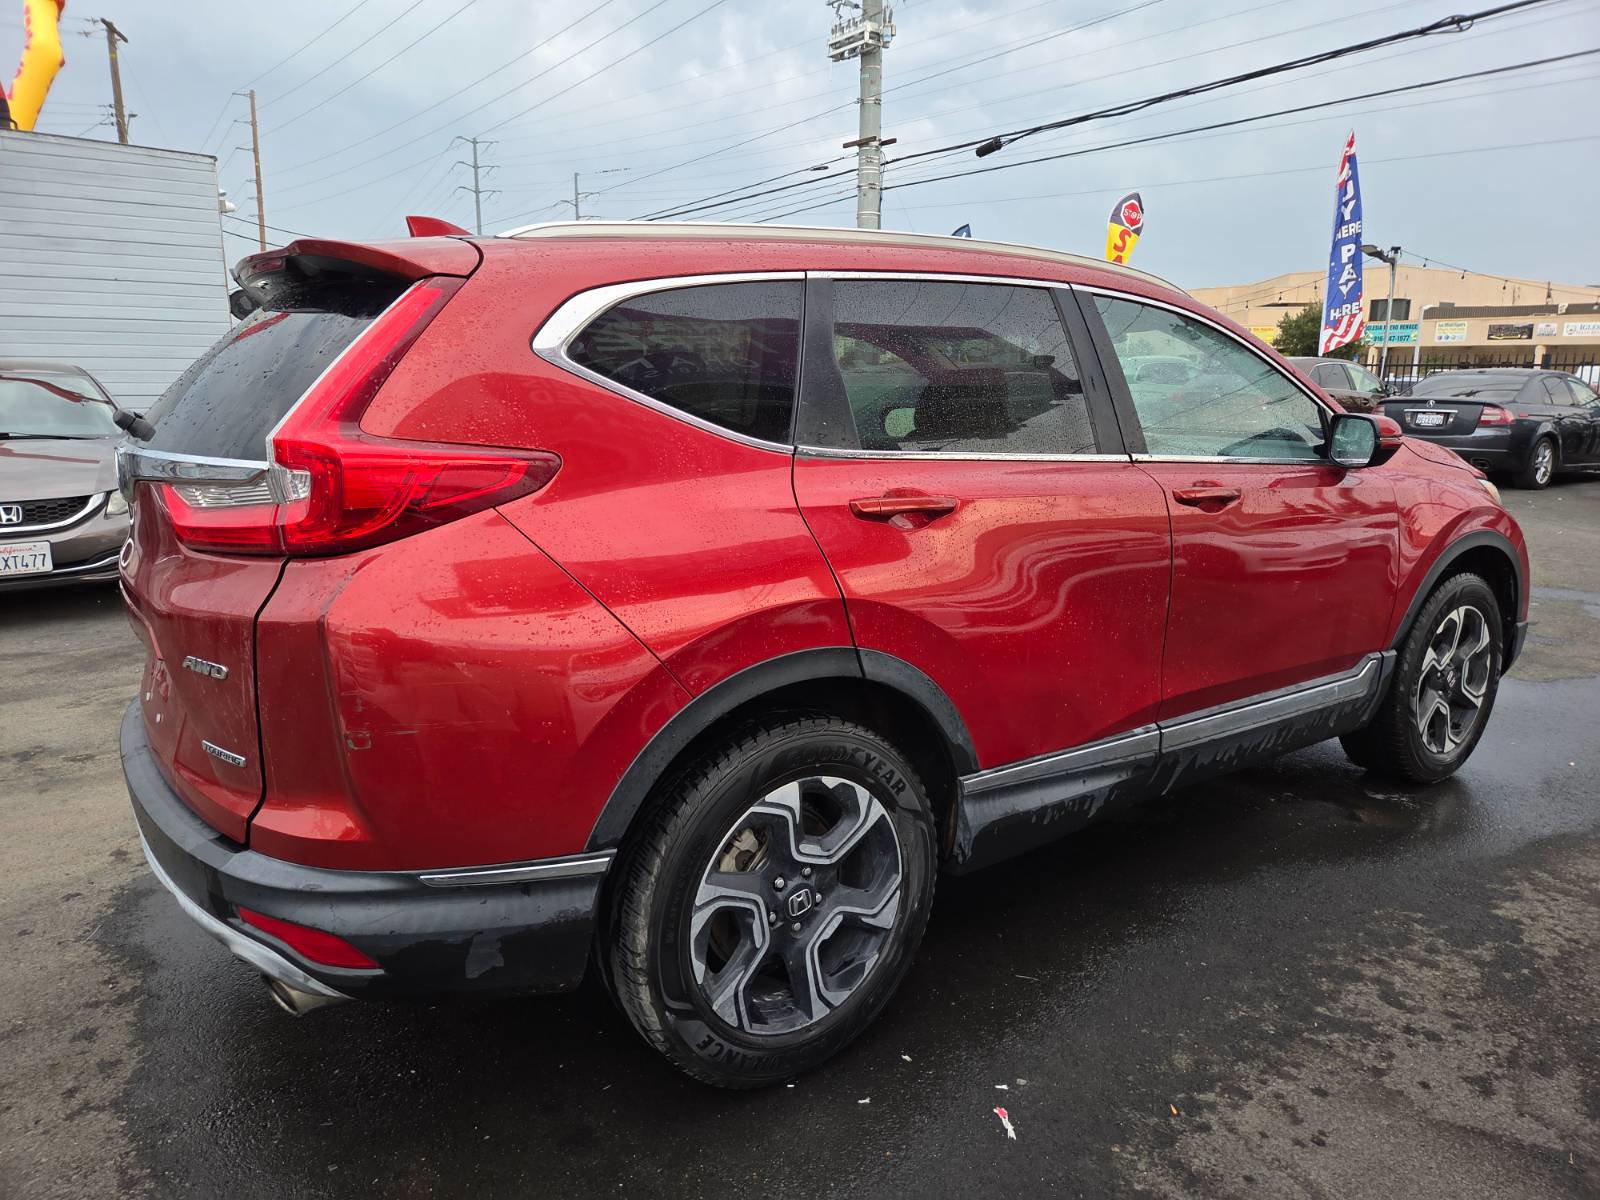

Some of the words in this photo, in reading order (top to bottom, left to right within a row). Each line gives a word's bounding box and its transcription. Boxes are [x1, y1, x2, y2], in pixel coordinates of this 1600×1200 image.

[1329, 301, 1361, 321] HRE
[0, 553, 46, 571] XT477
[182, 655, 229, 680] AWD
[201, 741, 246, 767] TOURING
